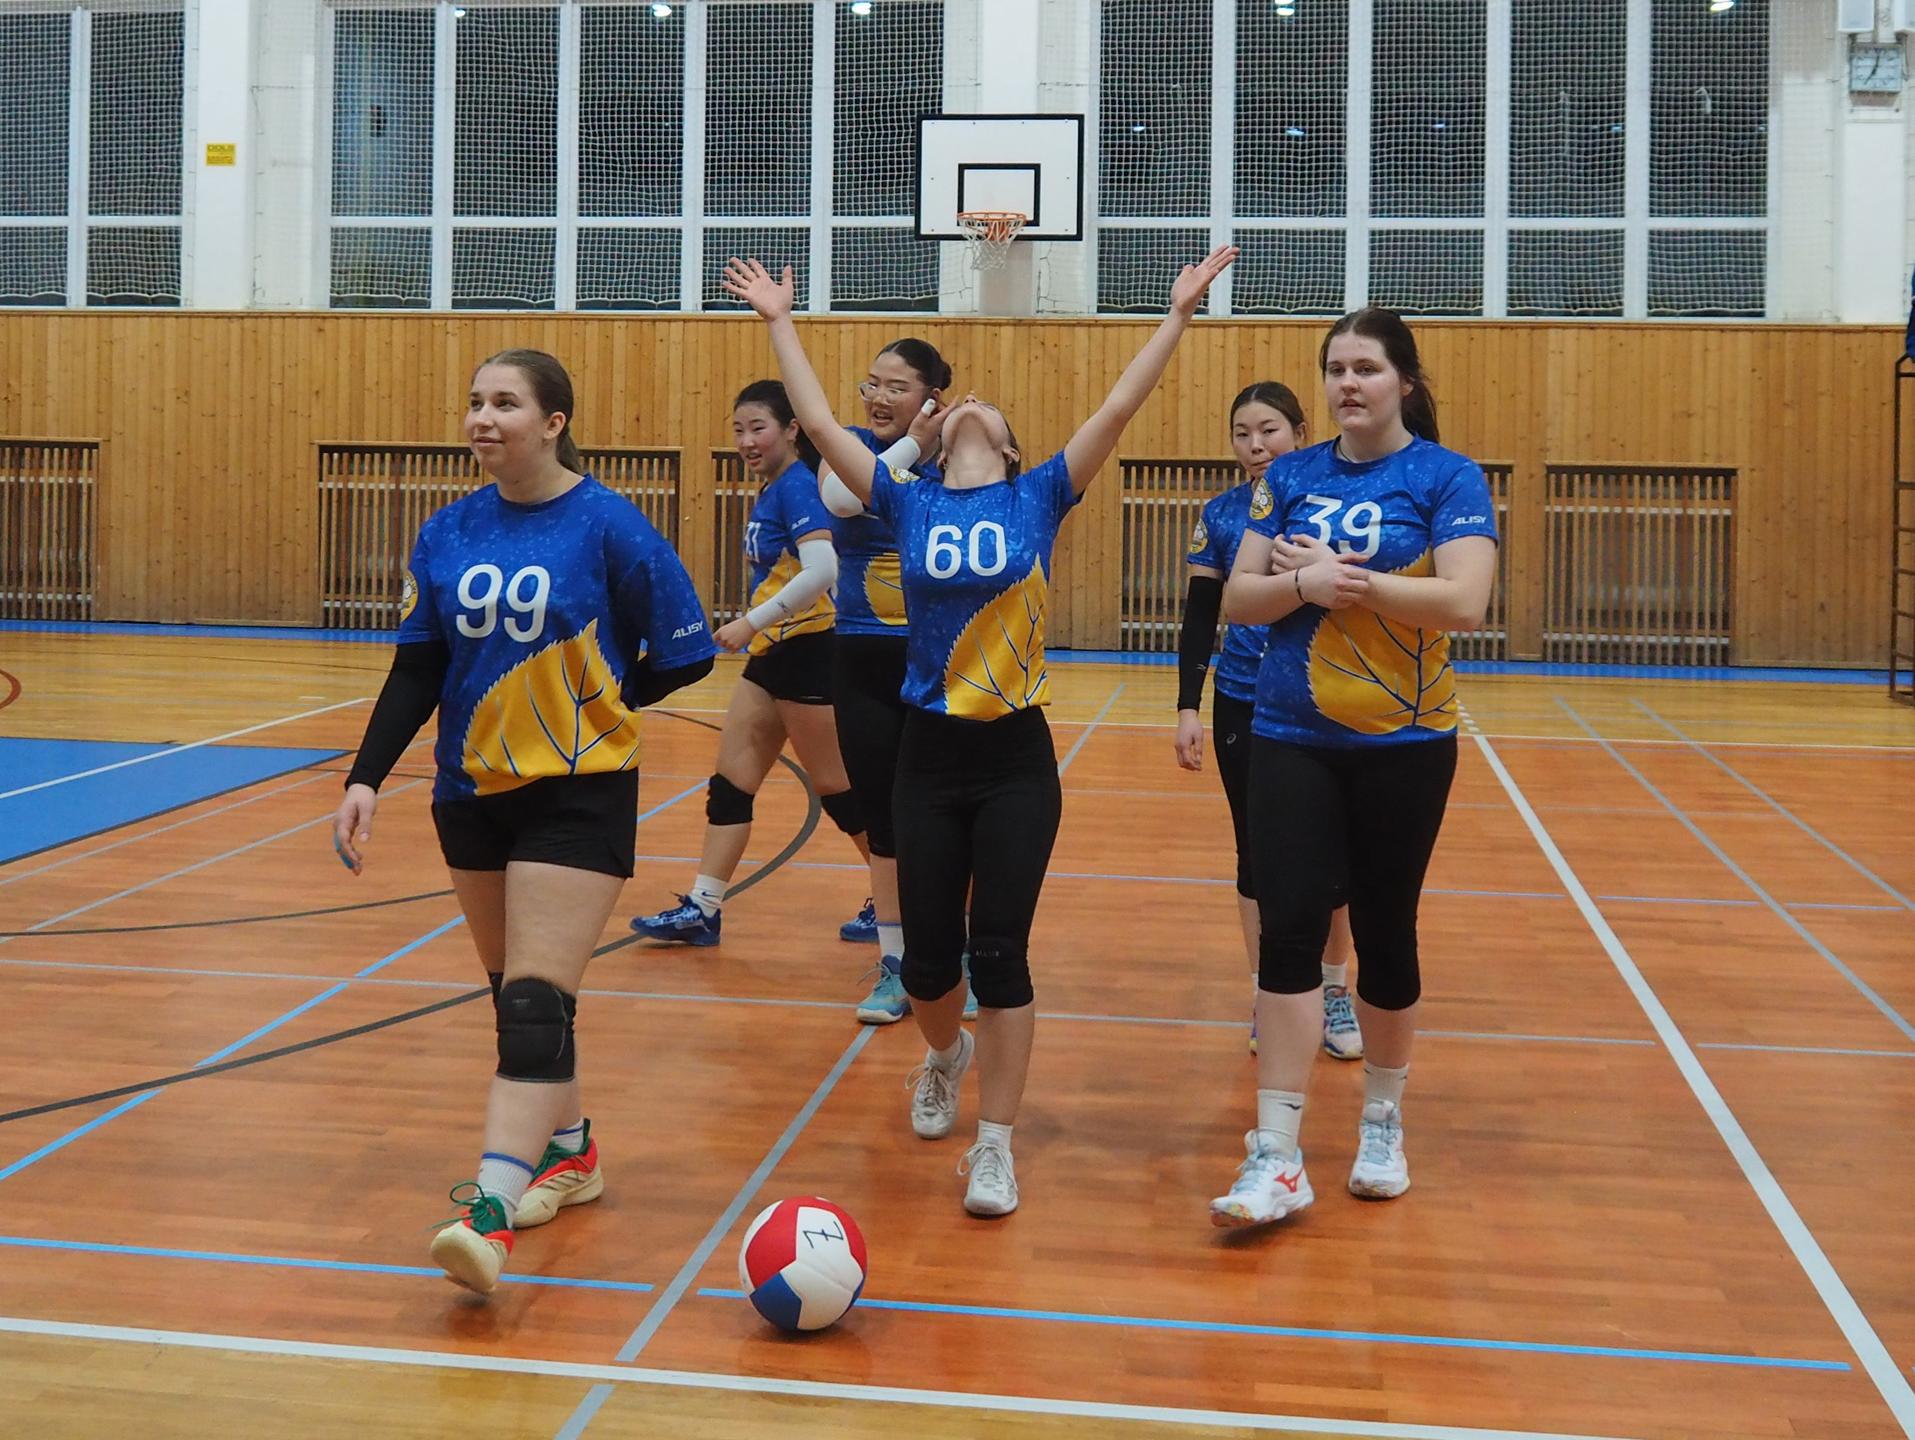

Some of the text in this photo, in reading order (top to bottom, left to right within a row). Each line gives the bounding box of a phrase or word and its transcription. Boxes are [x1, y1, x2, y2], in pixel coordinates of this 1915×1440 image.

[925, 520, 1007, 579] 60
[1306, 494, 1382, 558] 39
[1451, 515, 1487, 526] ALISY
[456, 563, 550, 643] 99
[672, 620, 704, 640] ALISY
